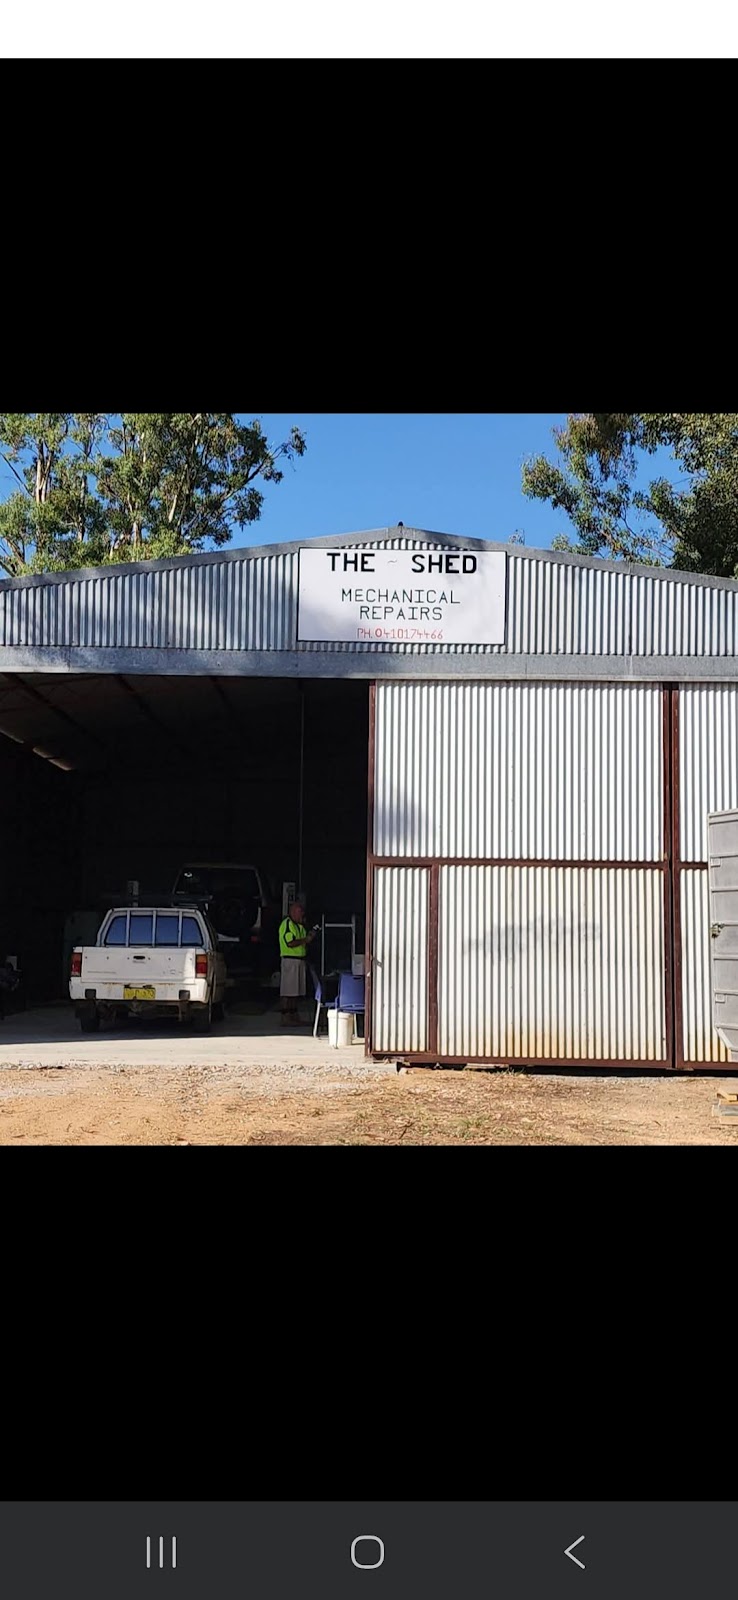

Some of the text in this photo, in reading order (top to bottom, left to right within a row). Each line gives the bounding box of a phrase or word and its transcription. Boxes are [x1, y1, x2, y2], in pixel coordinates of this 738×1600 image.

[327, 553, 375, 572] THE
[411, 554, 477, 574] SHED
[341, 588, 460, 604] MECHANICAL
[359, 606, 443, 620] REPAIRS
